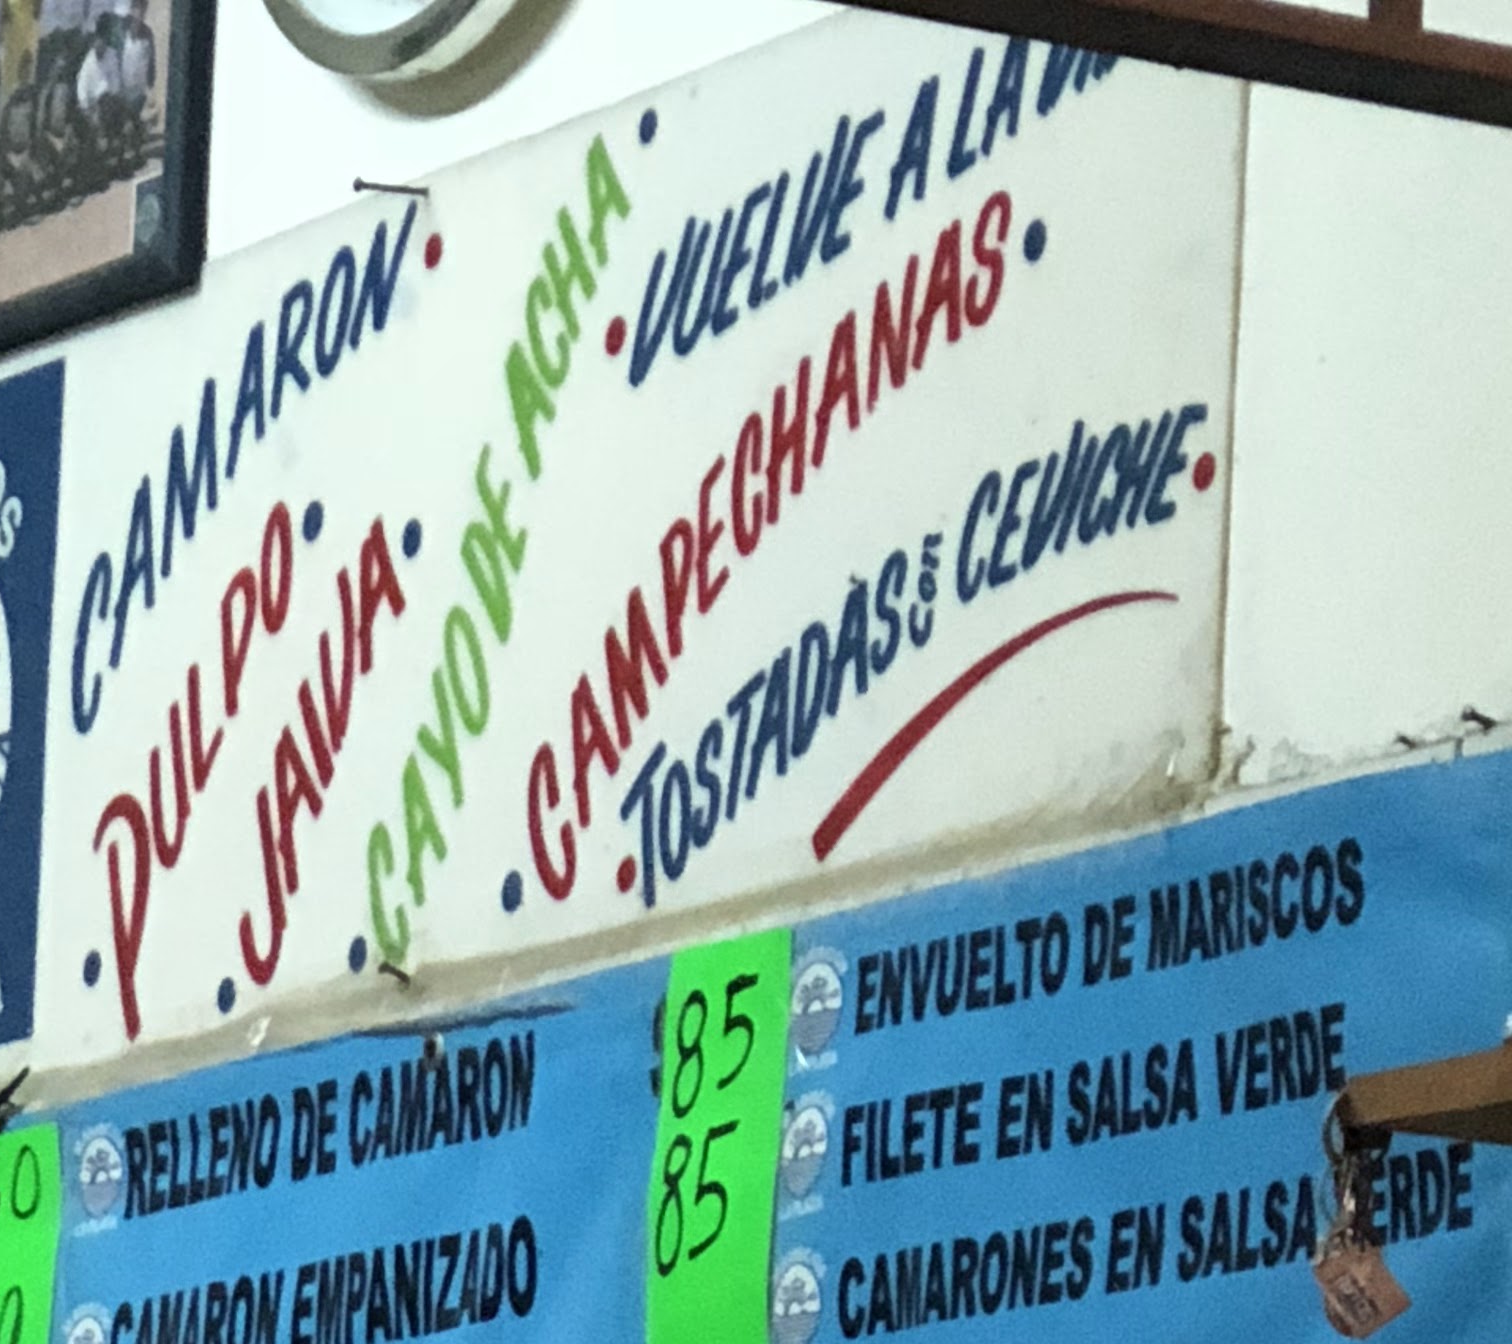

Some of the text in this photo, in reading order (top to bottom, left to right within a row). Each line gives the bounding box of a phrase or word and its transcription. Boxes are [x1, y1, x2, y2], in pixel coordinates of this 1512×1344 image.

[628, 109, 886, 388] VUELVE
[884, 75, 939, 222] A
[947, 36, 1030, 180] LA
[72, 200, 417, 735] CAMARON
[367, 133, 632, 968] CAYO DE ACHA
[527, 190, 1011, 901] CAMPECHANAS
[93, 501, 293, 1042] PULPO
[239, 513, 407, 987] JAIVA
[619, 548, 909, 908] TOSTADAS
[955, 402, 1208, 604] CEVICHE
[672, 975, 759, 1119] 85
[840, 1002, 1348, 1187] FILETE EN SALSA VERDE
[853, 836, 1366, 1036] ENVUELTO DE MARISCOS
[122, 1030, 536, 1220] RELLENO DE CAMARON
[654, 1119, 740, 1279] 85
[837, 1140, 1474, 1340] CAMARONES EN SALSA ERDE
